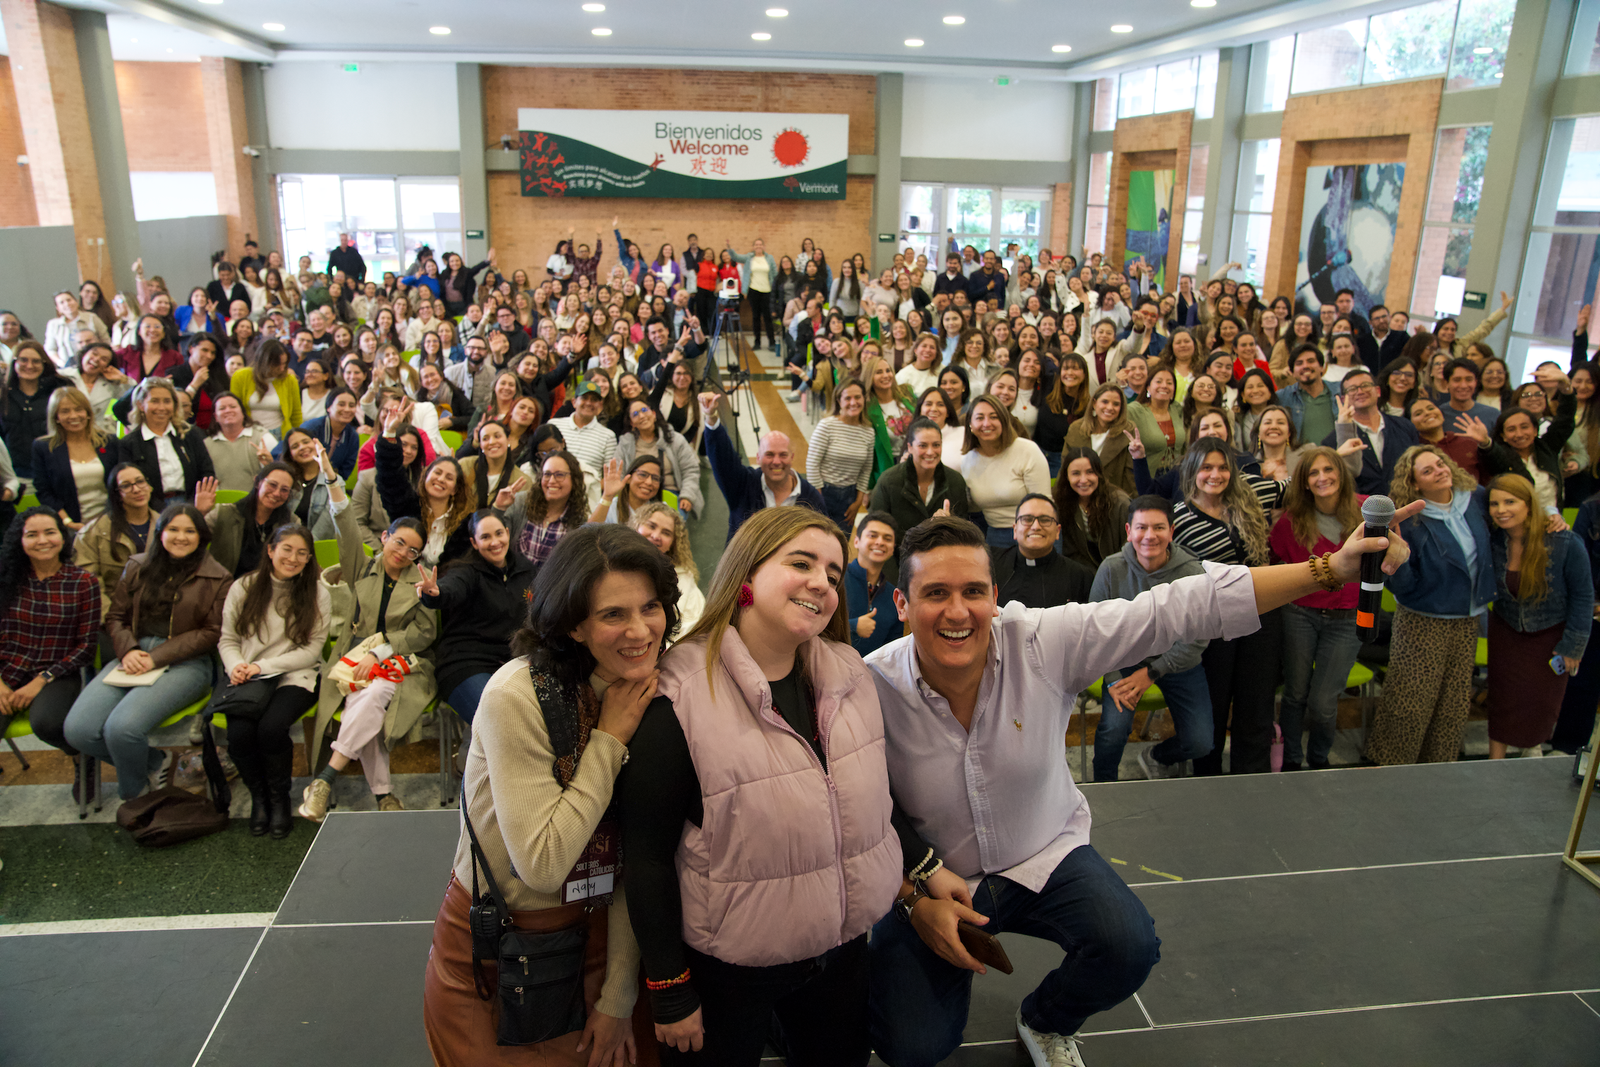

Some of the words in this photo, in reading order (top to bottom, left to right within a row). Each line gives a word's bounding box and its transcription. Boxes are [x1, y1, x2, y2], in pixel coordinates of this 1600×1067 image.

[655, 122, 763, 141] Bienvenidos
[670, 139, 749, 155] Welcome
[690, 155, 729, 176] 欢迎
[799, 182, 839, 194] Vermont
